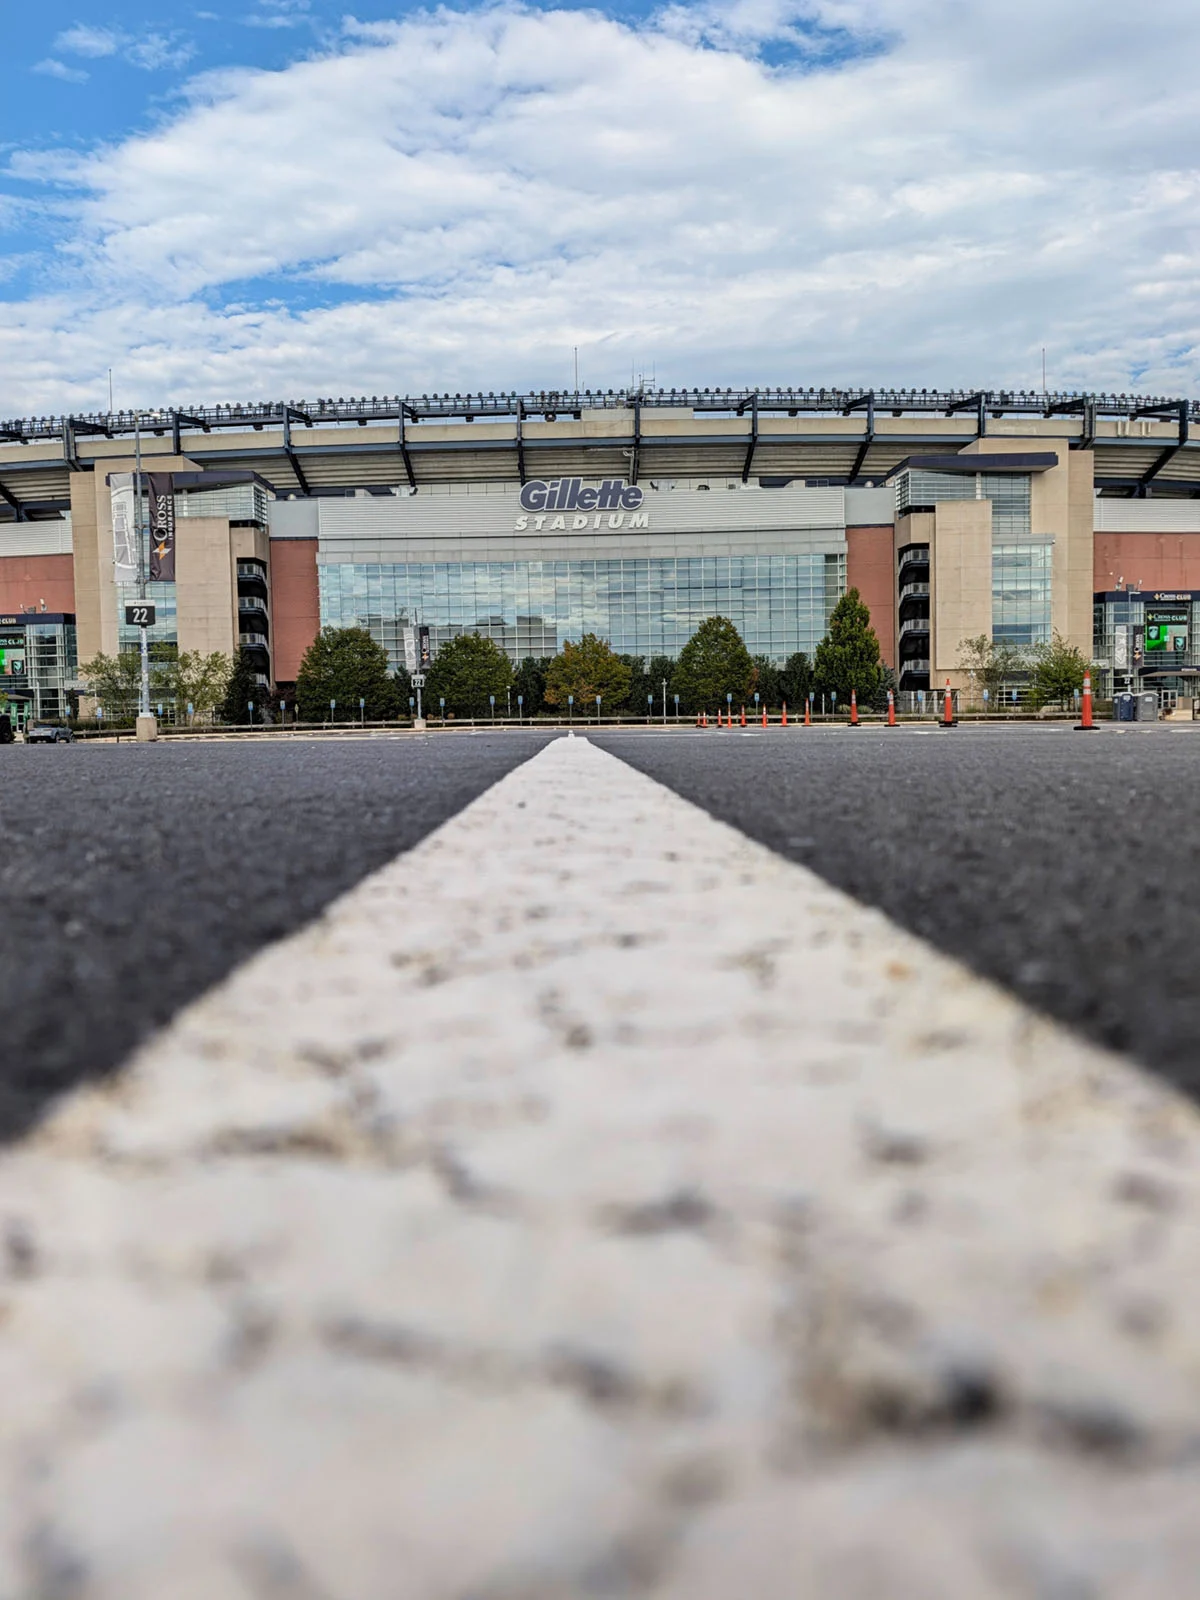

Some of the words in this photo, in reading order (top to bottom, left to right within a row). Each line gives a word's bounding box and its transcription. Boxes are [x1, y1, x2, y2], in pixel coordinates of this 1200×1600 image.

[519, 477, 643, 511] Gillette
[514, 513, 649, 531] STADIUM
[132, 608, 148, 623] 22
